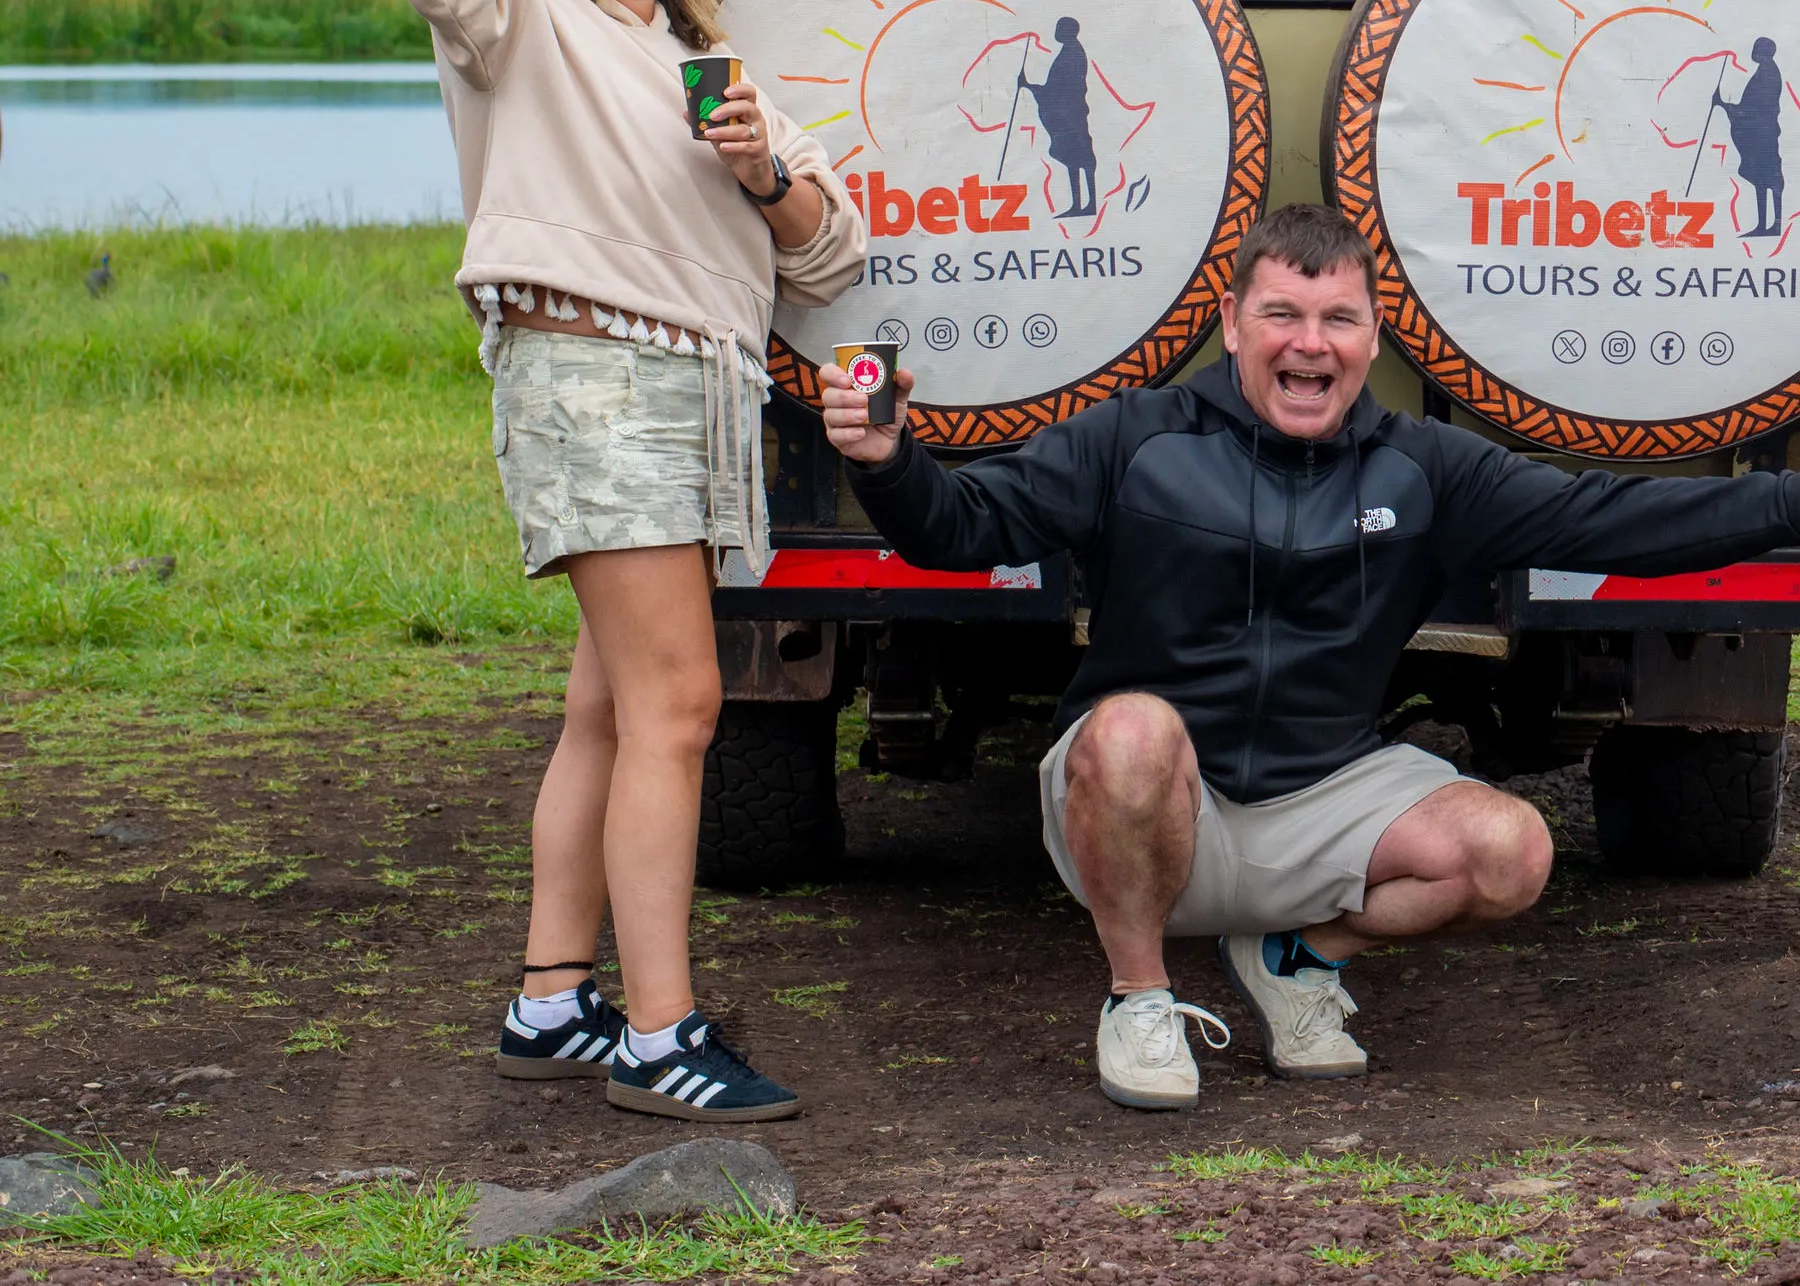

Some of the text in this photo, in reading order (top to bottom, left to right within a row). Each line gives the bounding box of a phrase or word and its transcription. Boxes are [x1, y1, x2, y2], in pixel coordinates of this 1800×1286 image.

[1457, 181, 1715, 249] Tribetz
[931, 253, 961, 284] &
[973, 246, 1143, 282] SAFARIS
[1457, 264, 1600, 297] TOURS
[1612, 266, 1642, 297] &
[1364, 509, 1381, 518] THE
[1363, 523, 1382, 533] FACE
[1705, 577, 1722, 587] 3M
